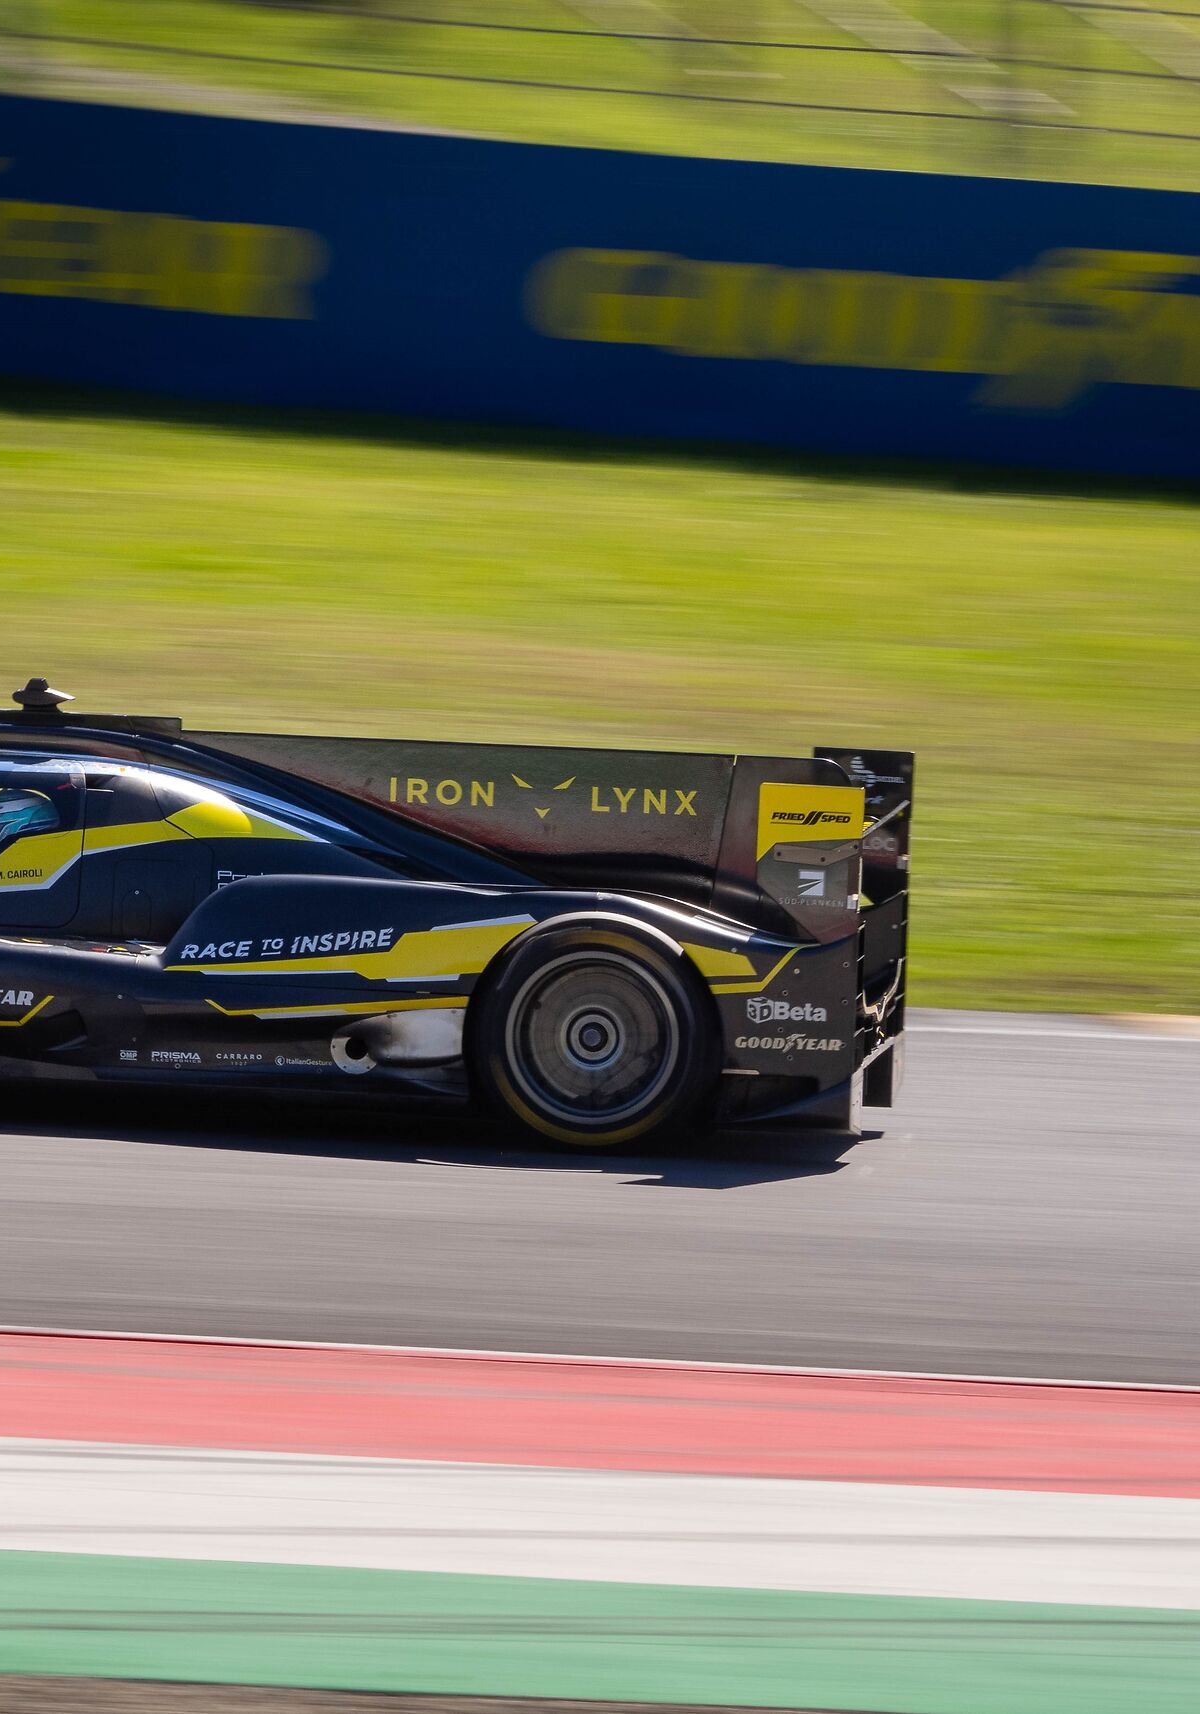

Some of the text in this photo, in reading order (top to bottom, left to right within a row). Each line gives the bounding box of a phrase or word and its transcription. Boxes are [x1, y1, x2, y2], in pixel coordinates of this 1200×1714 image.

[389, 776, 698, 817] IRON LYNX
[771, 811, 851, 824] FRIED SPED
[7, 868, 43, 879] CAIROLI
[180, 926, 395, 959] RACE TO INSPIRE
[735, 1033, 843, 1053] GOODYEAR
[151, 1050, 201, 1060] PRISMA
